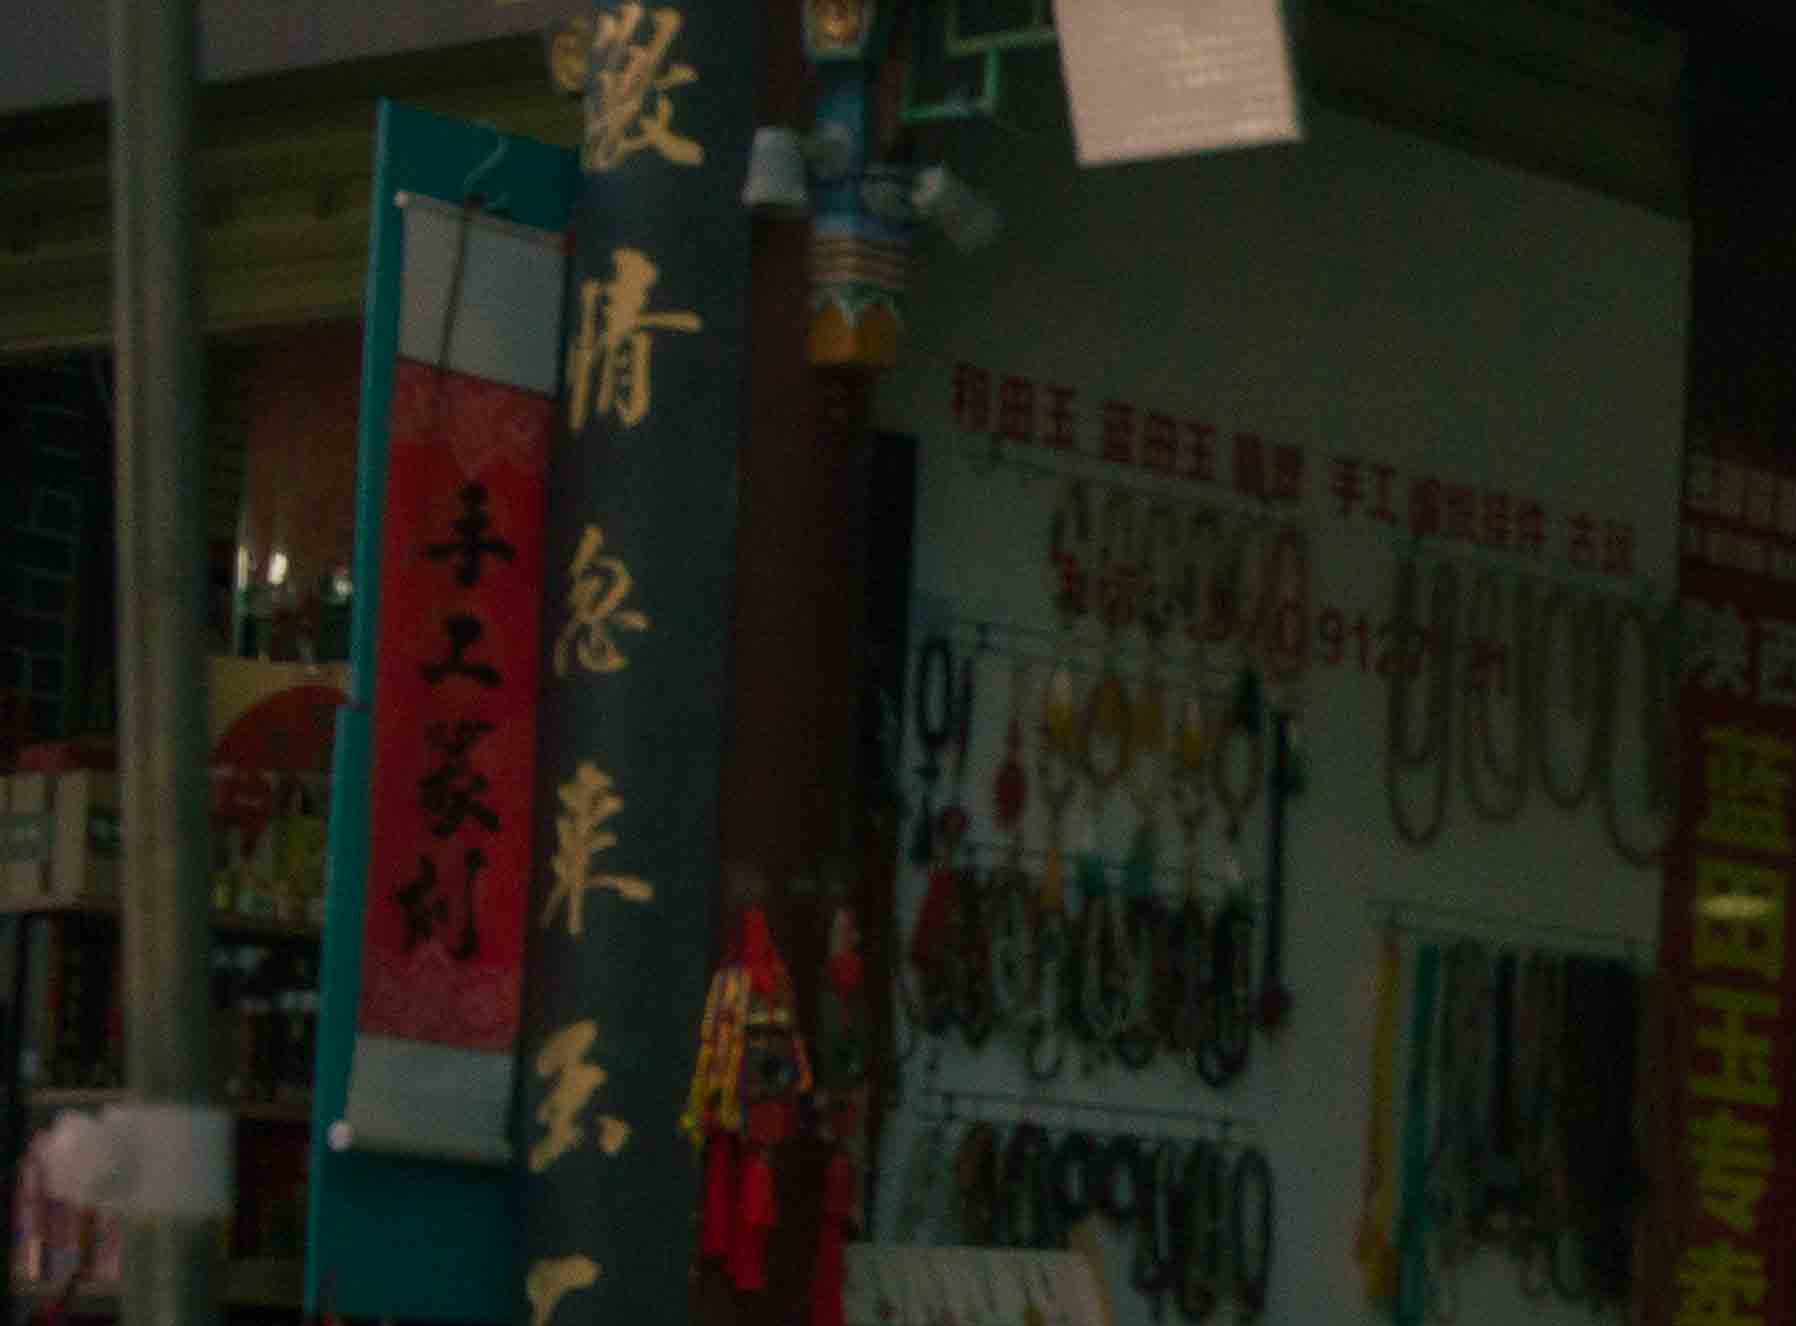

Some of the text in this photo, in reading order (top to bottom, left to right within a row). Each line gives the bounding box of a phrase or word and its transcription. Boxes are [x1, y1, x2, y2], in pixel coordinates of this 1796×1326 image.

[950, 362, 1078, 450] 和田玉
[1101, 400, 1217, 482] 蓝田玉
[394, 484, 514, 960] 手工篆刻
